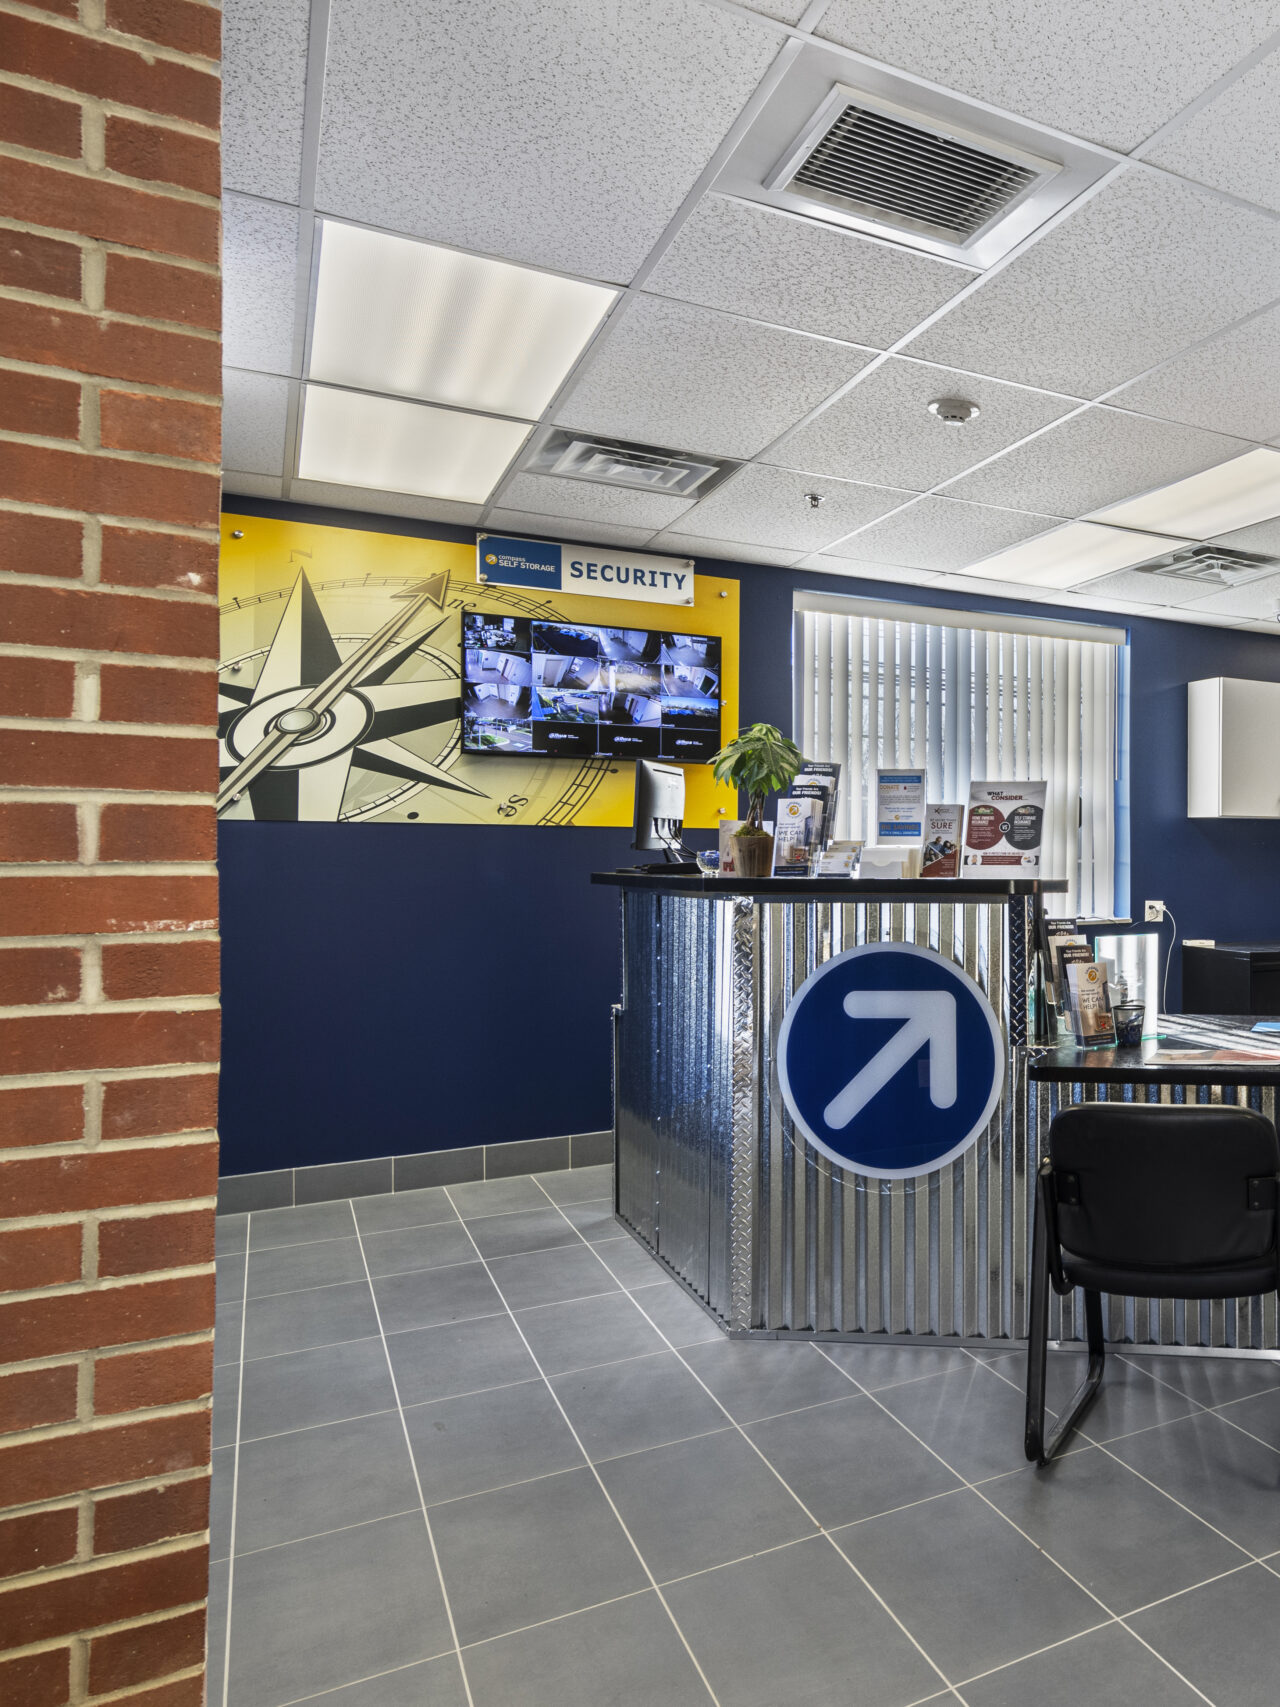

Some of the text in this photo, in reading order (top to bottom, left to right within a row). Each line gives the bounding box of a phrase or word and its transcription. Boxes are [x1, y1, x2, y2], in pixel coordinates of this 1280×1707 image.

[498, 560, 556, 572] SELF STORAGE
[570, 560, 686, 590] SECURITY
